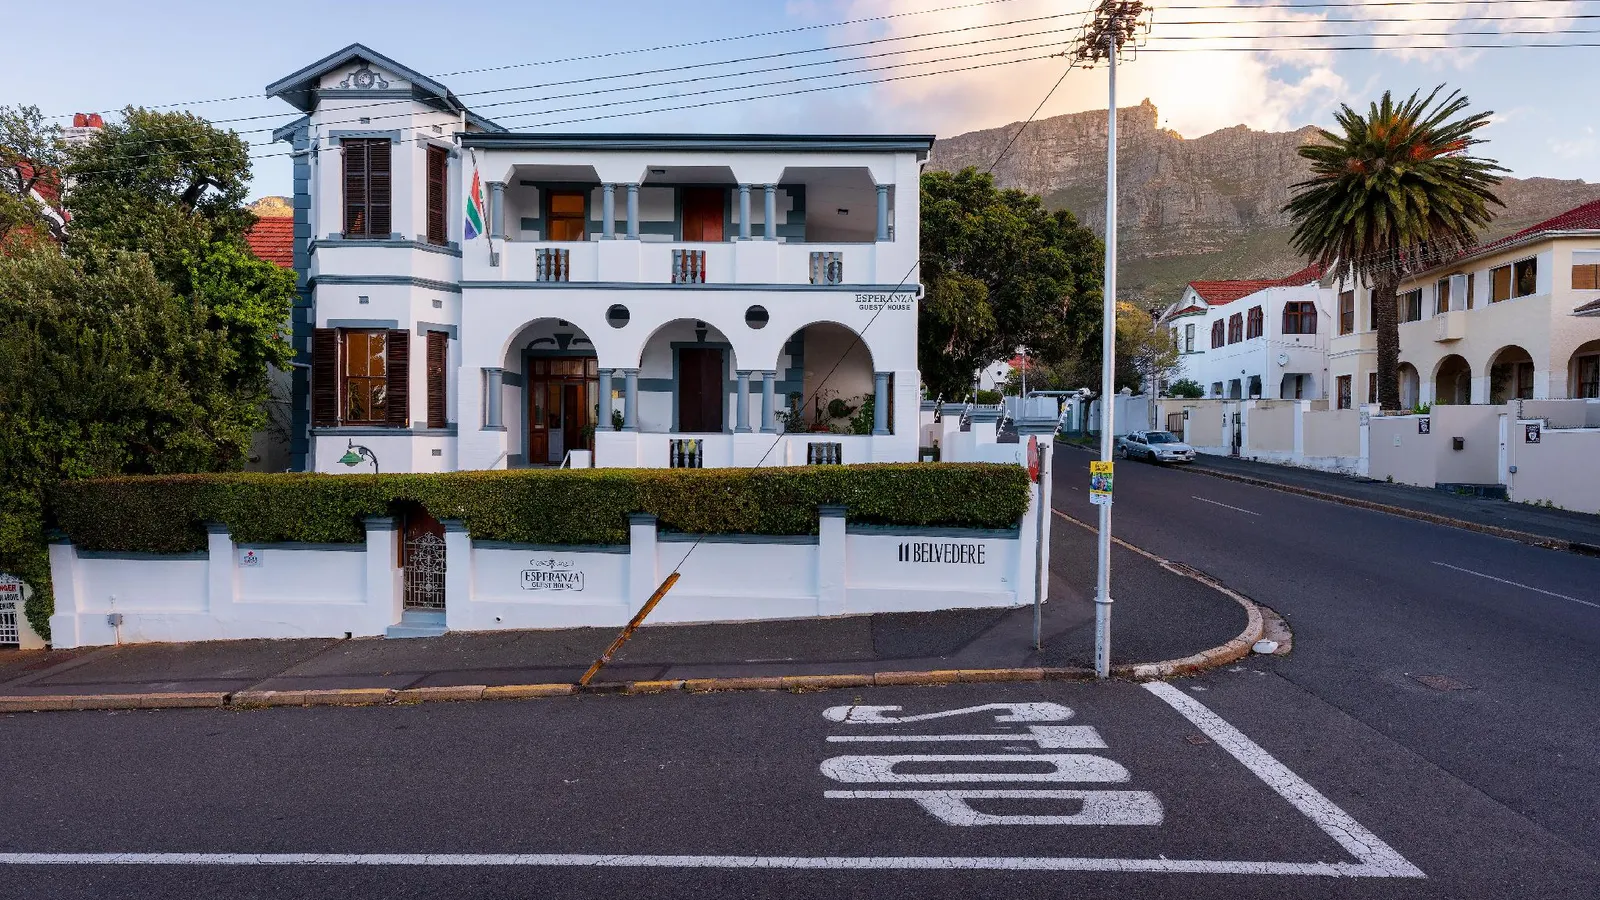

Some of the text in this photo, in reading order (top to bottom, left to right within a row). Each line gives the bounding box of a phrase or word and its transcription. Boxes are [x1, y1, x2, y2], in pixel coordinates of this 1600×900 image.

[855, 294, 914, 303] ESPERANZA
[899, 543, 985, 564] 11 BELVEDERE
[526, 572, 580, 582] ESPERANZA
[819, 702, 1165, 826] STOP
